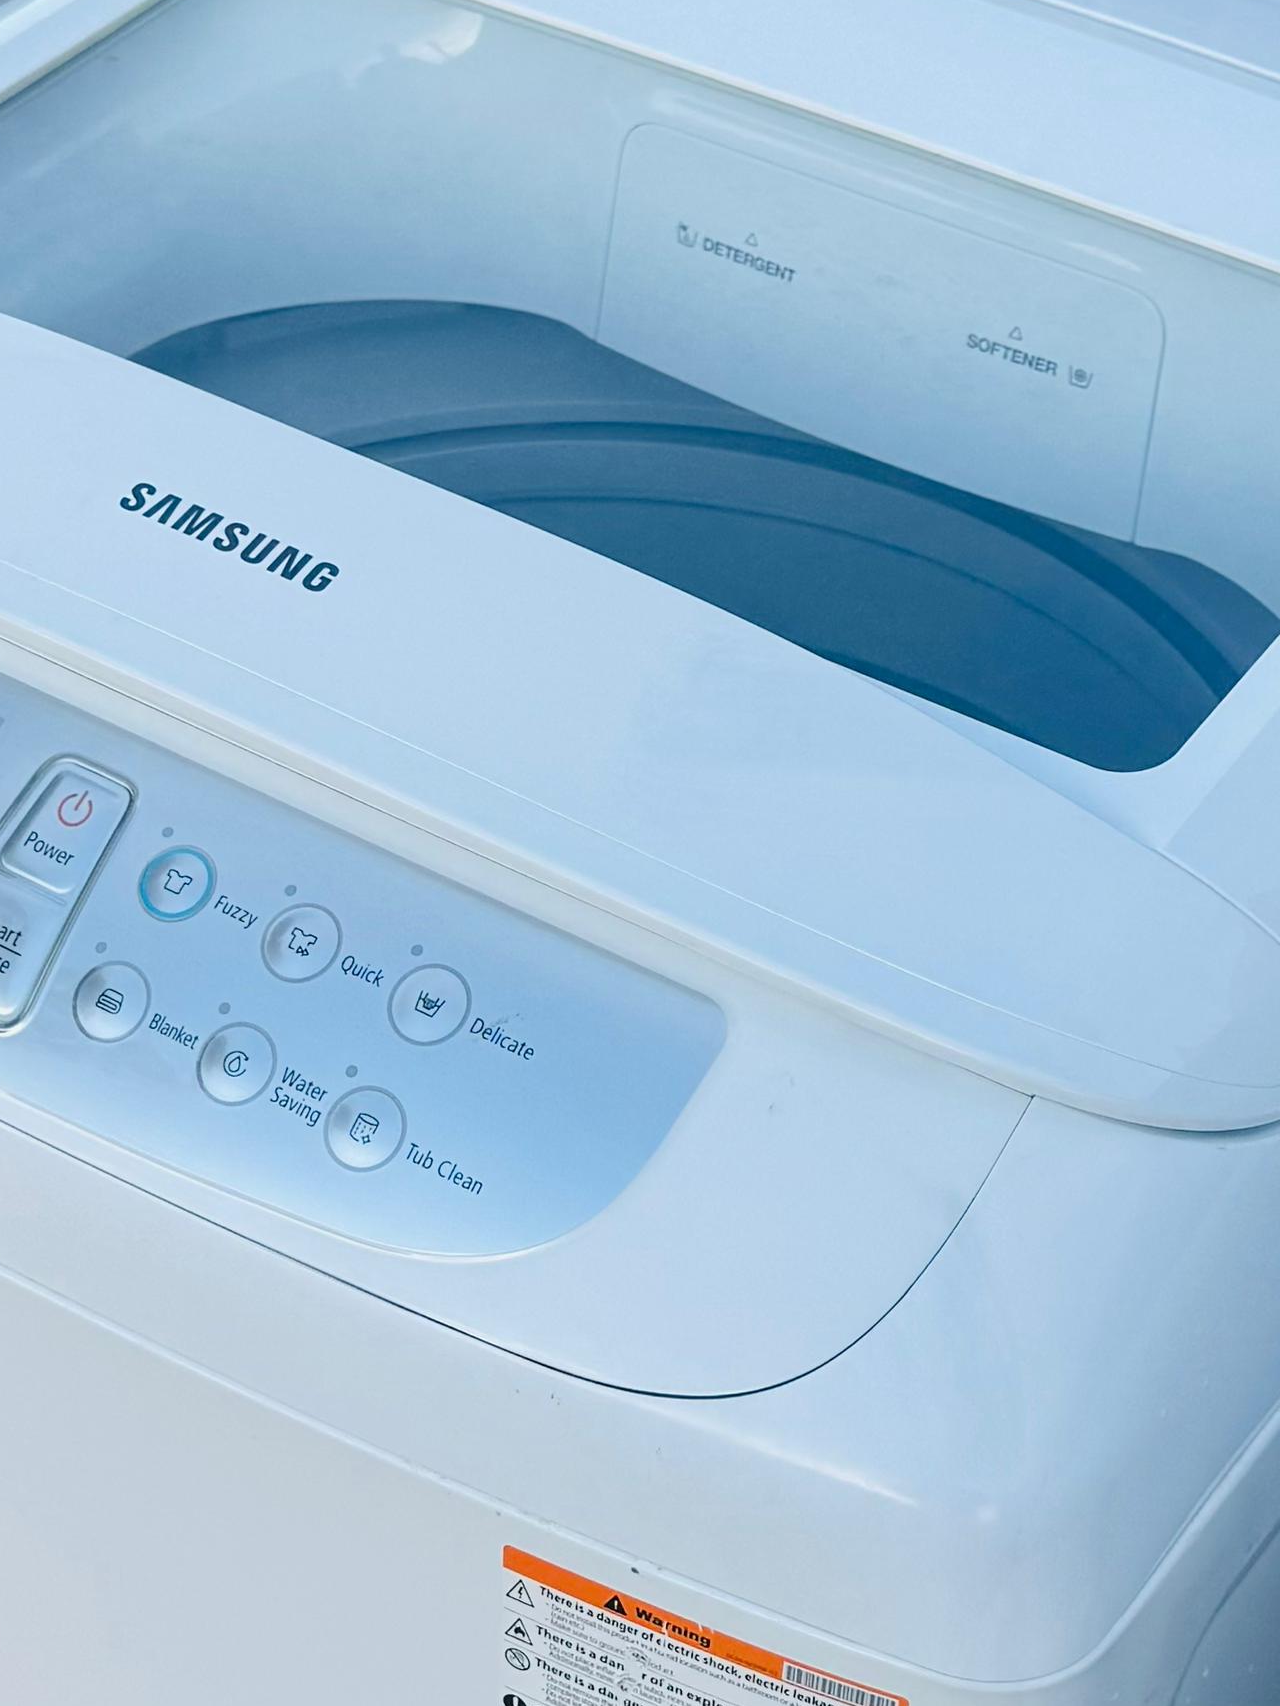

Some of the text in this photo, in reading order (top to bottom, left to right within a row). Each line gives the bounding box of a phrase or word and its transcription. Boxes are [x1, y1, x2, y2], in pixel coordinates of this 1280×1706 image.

[702, 237, 796, 284] DETERGENT
[966, 333, 1058, 376] SOFTENER
[119, 481, 340, 594] SAMSUNG
[23, 830, 76, 868] Power
[213, 894, 259, 930] Fuzzy
[340, 954, 385, 988] Quick
[148, 1012, 200, 1051] Blanket
[469, 1017, 536, 1062] Delicate
[280, 1066, 329, 1103] Water
[269, 1086, 322, 1129] Saving
[405, 1141, 484, 1196] Tub Clean
[539, 1585, 572, 1608] There
[574, 1599, 584, 1613] is
[586, 1606, 594, 1617] a
[597, 1609, 638, 1639] danger
[640, 1626, 655, 1644] of
[701, 1652, 742, 1678] shock,
[744, 1669, 790, 1696] electric
[635, 1605, 711, 1650] Warning
[534, 1657, 571, 1681] There
[574, 1673, 584, 1687] is
[587, 1680, 595, 1691] a
[535, 1625, 573, 1649] There
[575, 1641, 586, 1655] is
[588, 1649, 596, 1659] a
[599, 1651, 646, 1681] danr
[645, 1672, 662, 1688] of
[666, 1683, 683, 1696] an
